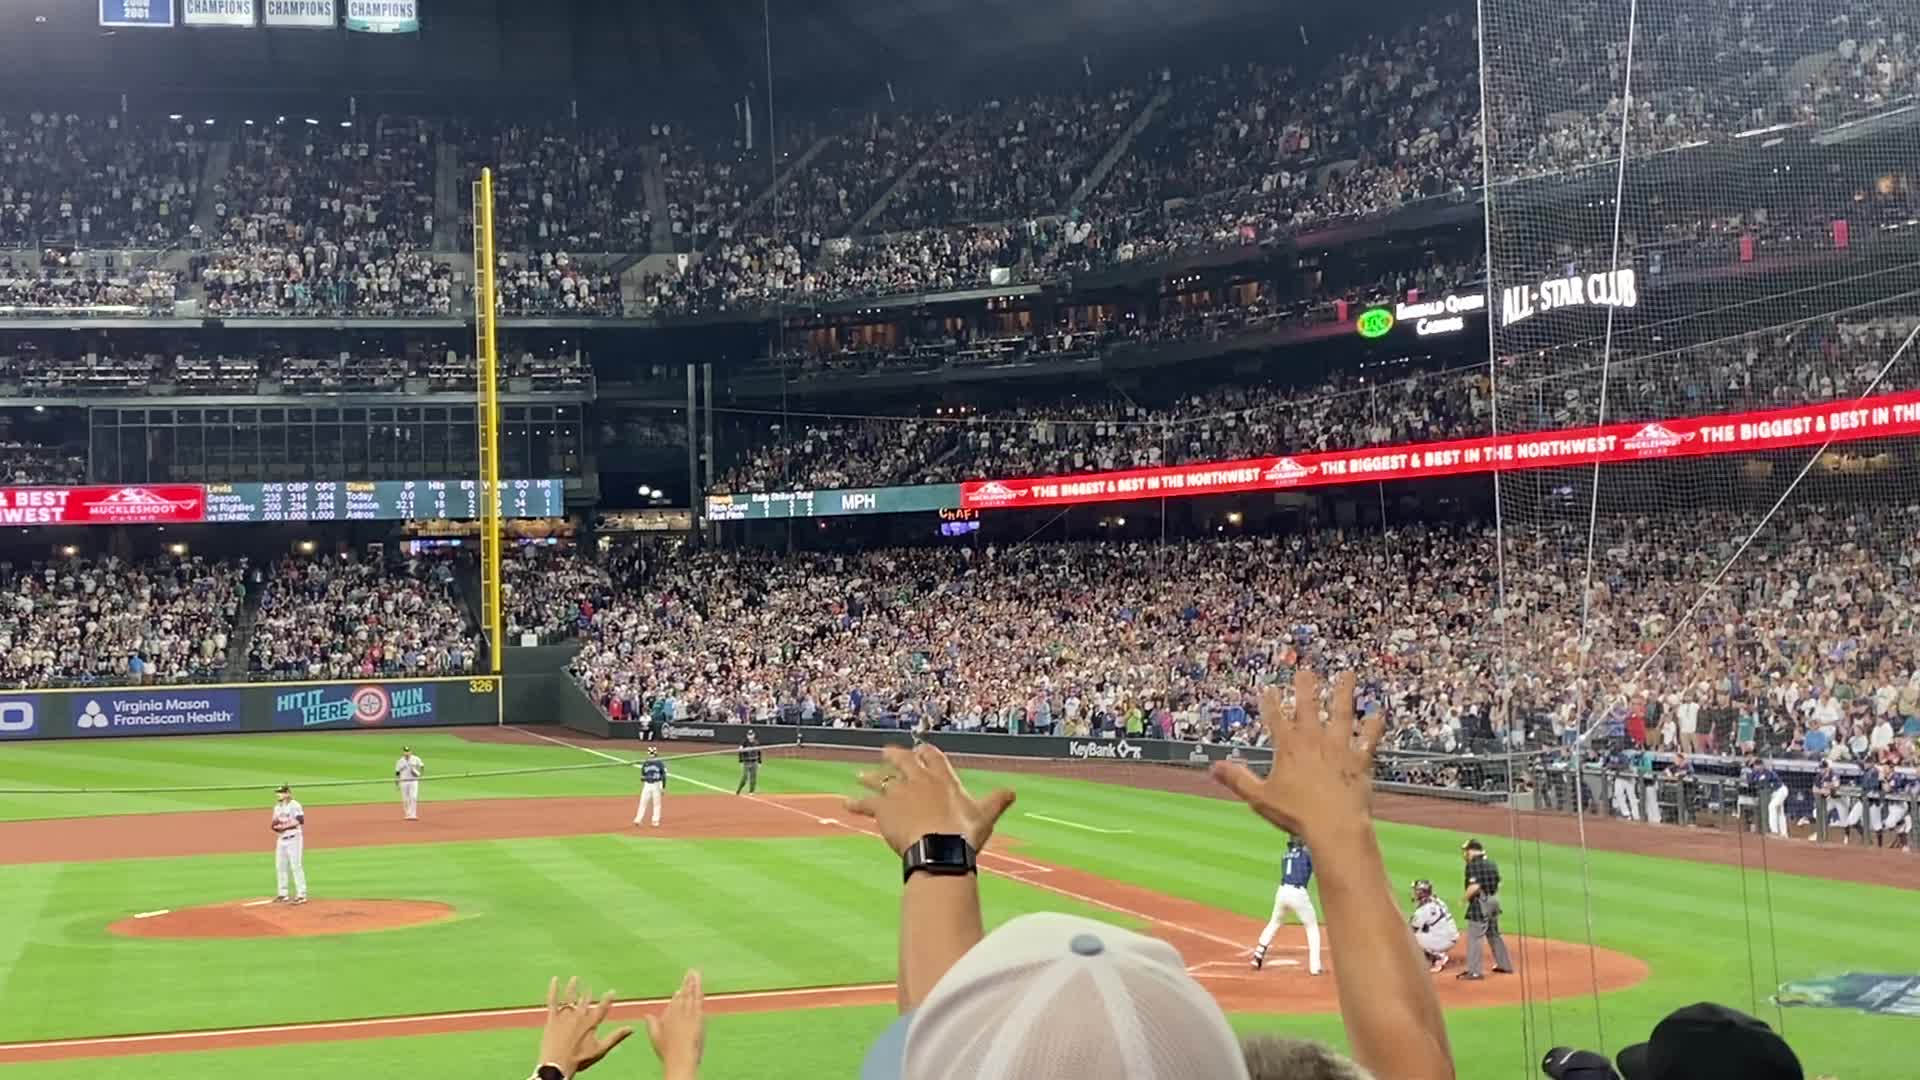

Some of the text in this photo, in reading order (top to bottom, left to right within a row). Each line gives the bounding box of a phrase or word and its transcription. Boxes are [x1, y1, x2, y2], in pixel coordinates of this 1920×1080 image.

[187, 0, 250, 15] CHAMPIONS
[268, 0, 332, 16] CHAMPIONS
[351, 1, 414, 17] CHAMPIONS
[1587, 268, 1637, 307] CLUB
[1700, 427, 1735, 443] THE
[1740, 417, 1810, 441] BIGGEST
[1816, 415, 1826, 432] &
[1830, 410, 1869, 430] BEST
[1872, 407, 1889, 425] IN
[1320, 435, 1617, 475] THE BIGGEST & BEST IN THE NORTHWEST
[262, 483, 283, 492] AVG
[287, 483, 309, 491] OBP
[315, 482, 336, 491] OPS
[1032, 485, 1058, 498] THE
[1061, 481, 1104, 497] BIGGEST
[1118, 478, 1145, 493] BEST
[1147, 477, 1159, 489] IN
[1161, 475, 1185, 488] THE
[1186, 468, 1261, 487] NORTHWEST
[16, 491, 69, 506] BEST
[345, 492, 373, 502] Today
[842, 494, 876, 510] MPH
[89, 505, 177, 515] MUCKLESHOOT
[345, 502, 379, 510] Season
[0, 507, 64, 522] WEST
[345, 511, 375, 519] Astros
[469, 680, 493, 693] 326
[277, 689, 324, 711] HIT IT
[391, 687, 424, 706] WIN
[113, 699, 210, 715] Virginia Mason
[306, 702, 349, 722] HERE
[390, 703, 432, 719] TICKETS
[114, 711, 231, 726] Franciscan Health
[1070, 741, 1117, 759] KeyBank
[1286, 858, 1293, 875] 1
